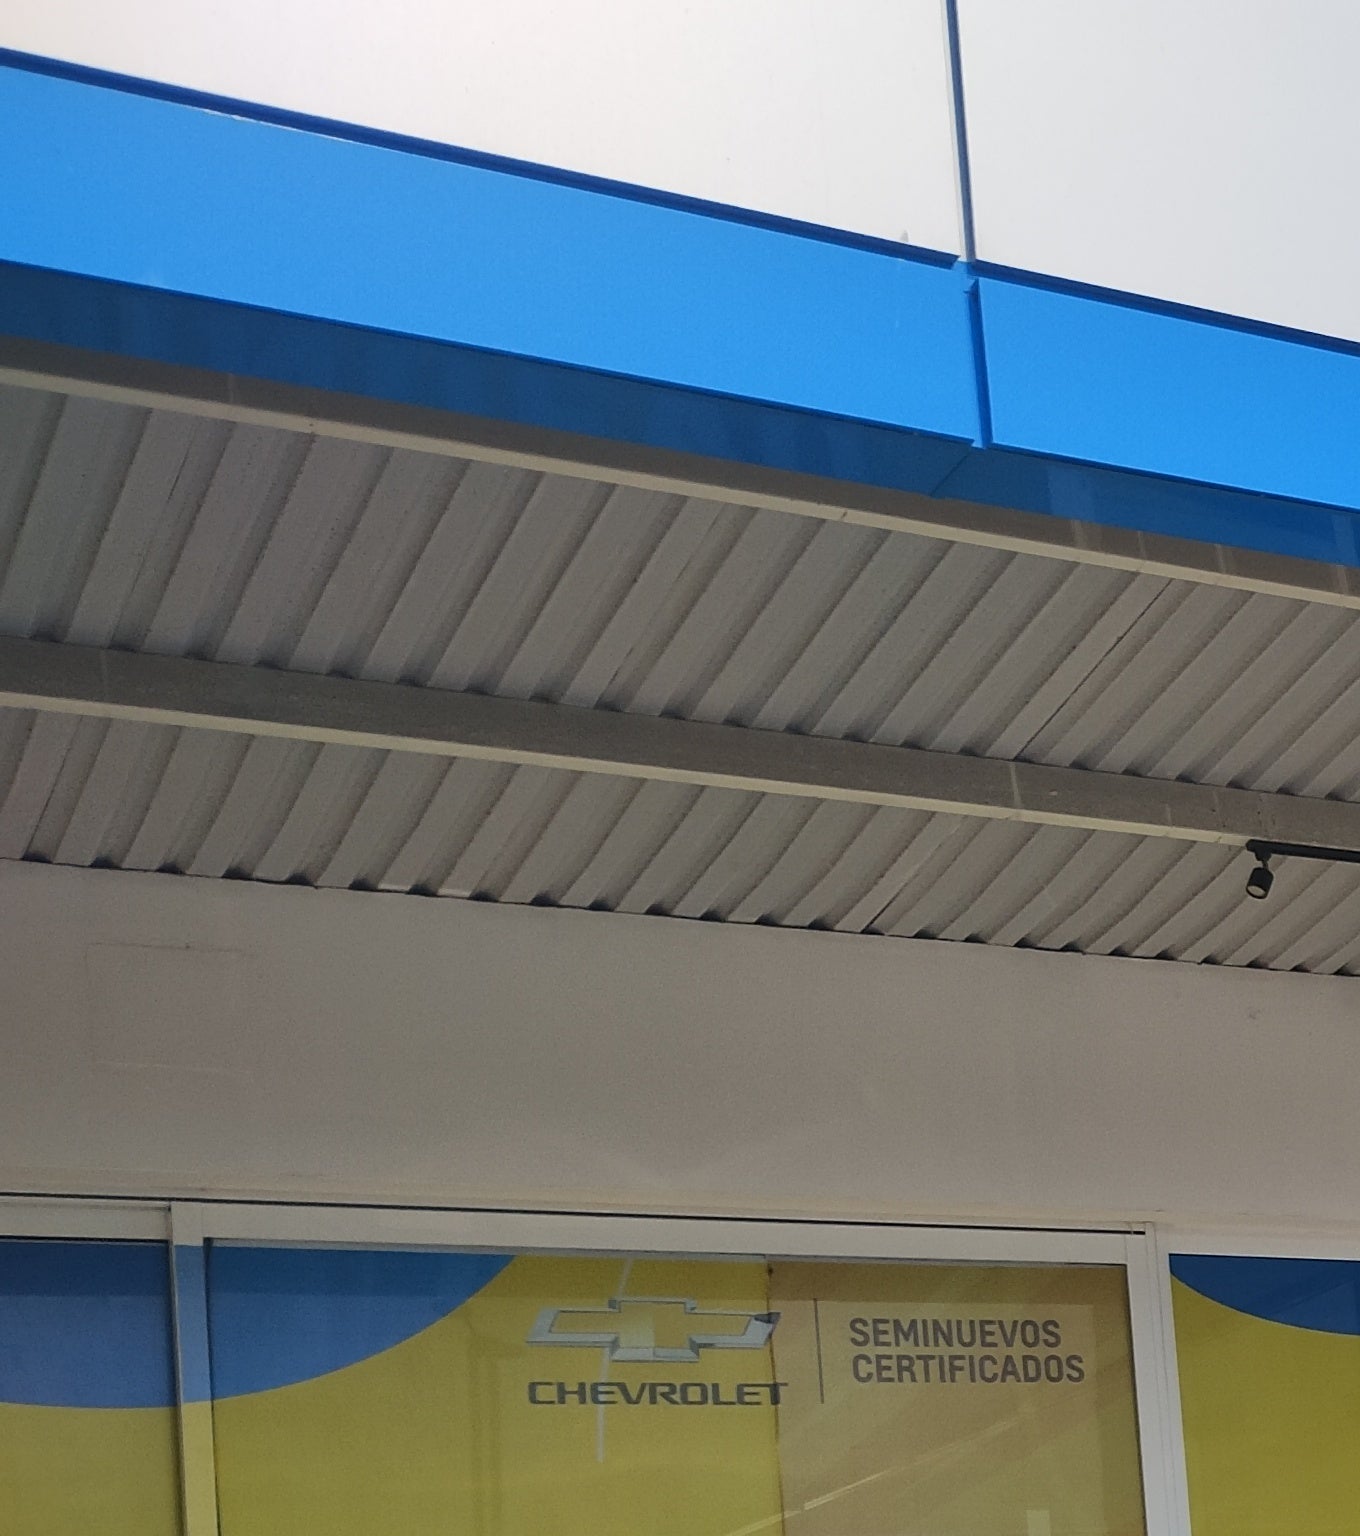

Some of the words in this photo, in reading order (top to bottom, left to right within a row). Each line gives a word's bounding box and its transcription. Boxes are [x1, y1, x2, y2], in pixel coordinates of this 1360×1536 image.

[848, 1317, 1063, 1349] SEMINUEVOS
[852, 1354, 1086, 1385] CERTIFICADOS
[526, 1380, 788, 1407] CHEVROLET
